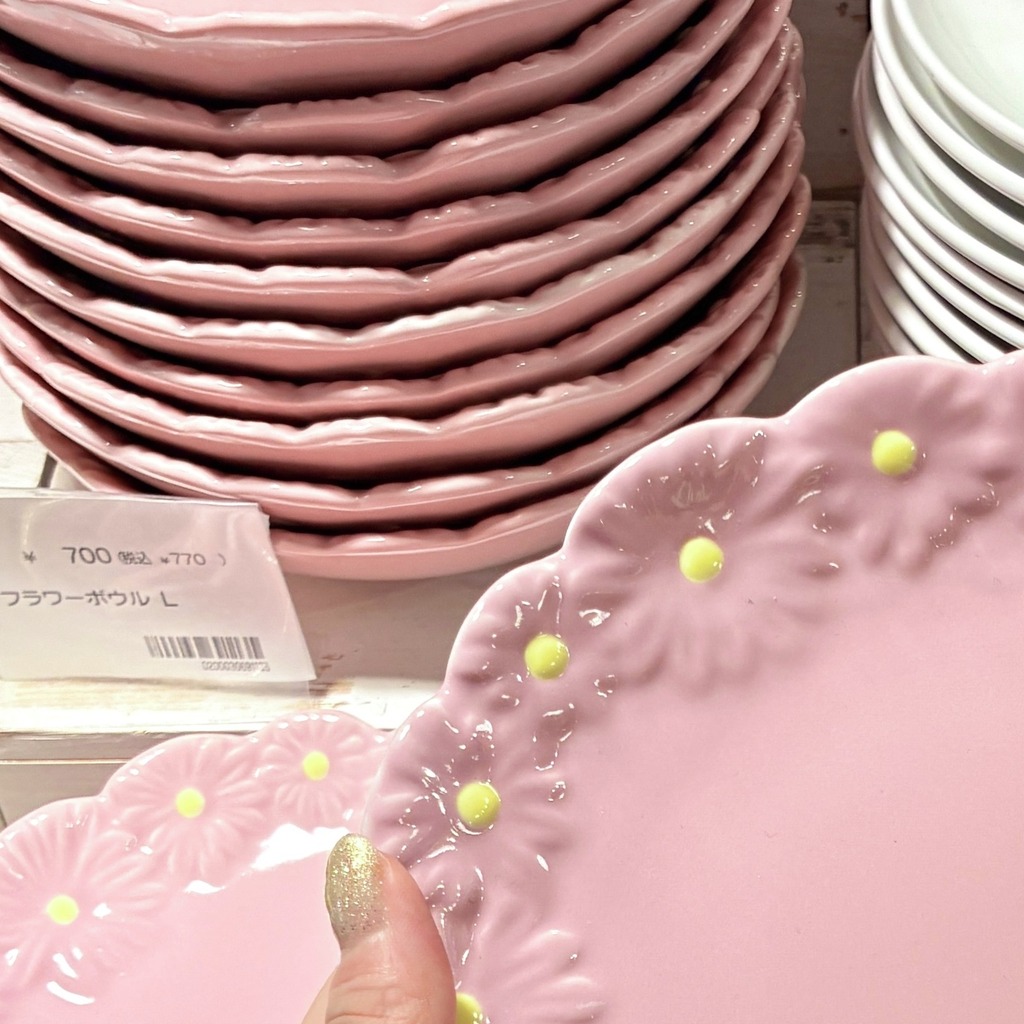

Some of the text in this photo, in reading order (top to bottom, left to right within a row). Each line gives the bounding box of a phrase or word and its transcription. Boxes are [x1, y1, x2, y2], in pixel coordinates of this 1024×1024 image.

[62, 546, 112, 566] 700
[1, 590, 179, 607] フラワーボウル L
